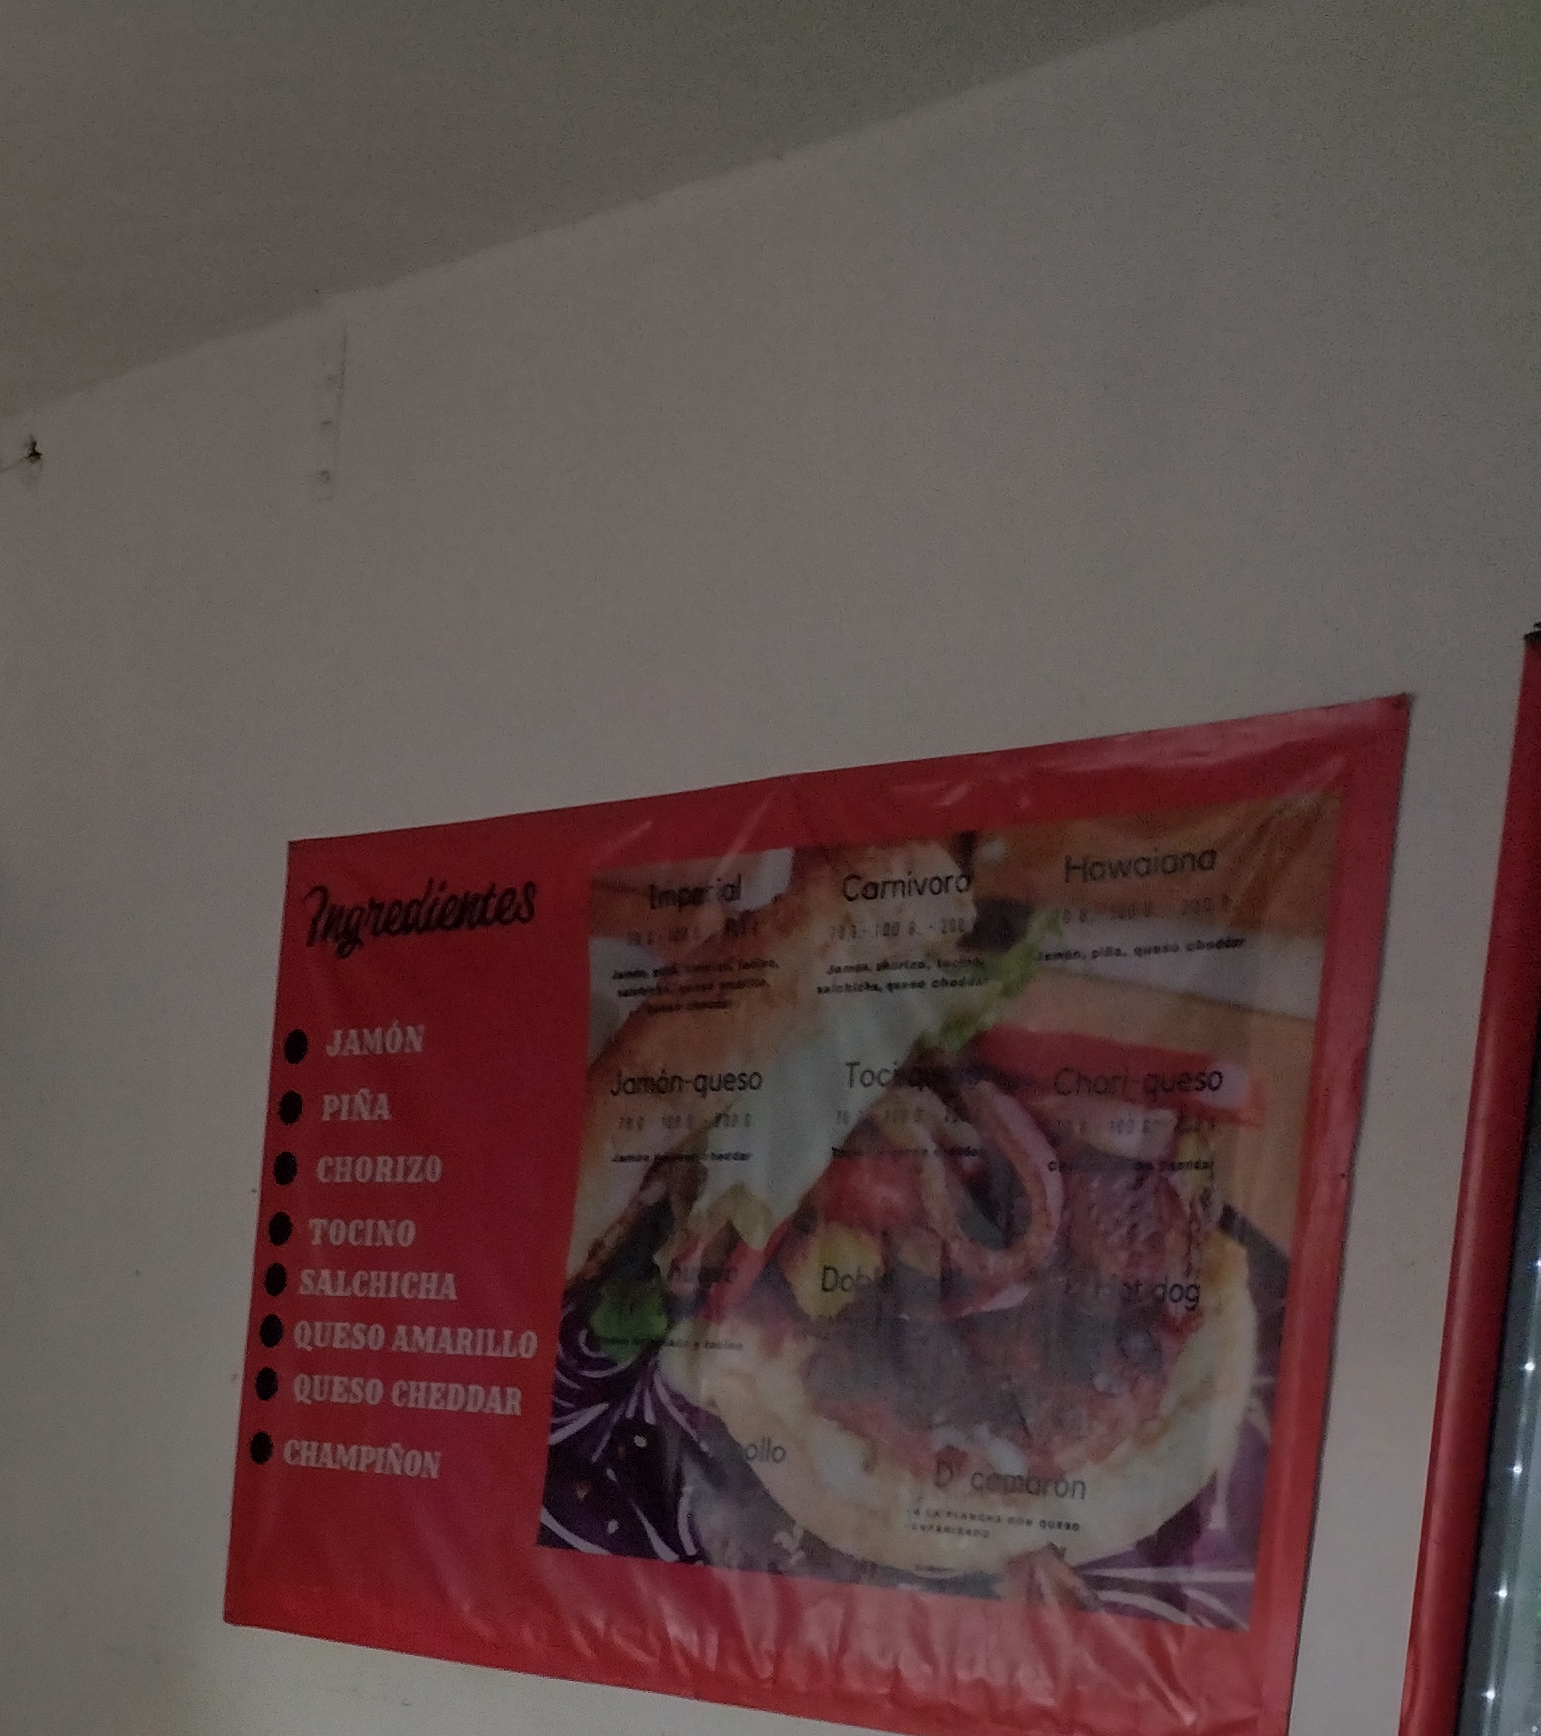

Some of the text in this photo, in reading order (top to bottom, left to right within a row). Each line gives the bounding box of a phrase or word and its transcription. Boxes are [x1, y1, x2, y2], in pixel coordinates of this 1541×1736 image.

[842, 871, 972, 902] Carnivora
[304, 877, 538, 959] Ingredientes
[326, 1019, 425, 1057] JAMÓN
[610, 1068, 764, 1099] Jamón-queso
[321, 1087, 392, 1121] PIÑA
[317, 1154, 443, 1184] CHORIZO
[309, 1218, 417, 1247] TOCINO
[299, 1268, 458, 1301] SALCHICHA
[293, 1320, 538, 1360] QUESO AMARILLO
[293, 1372, 523, 1416] QUESO CHEDDAR
